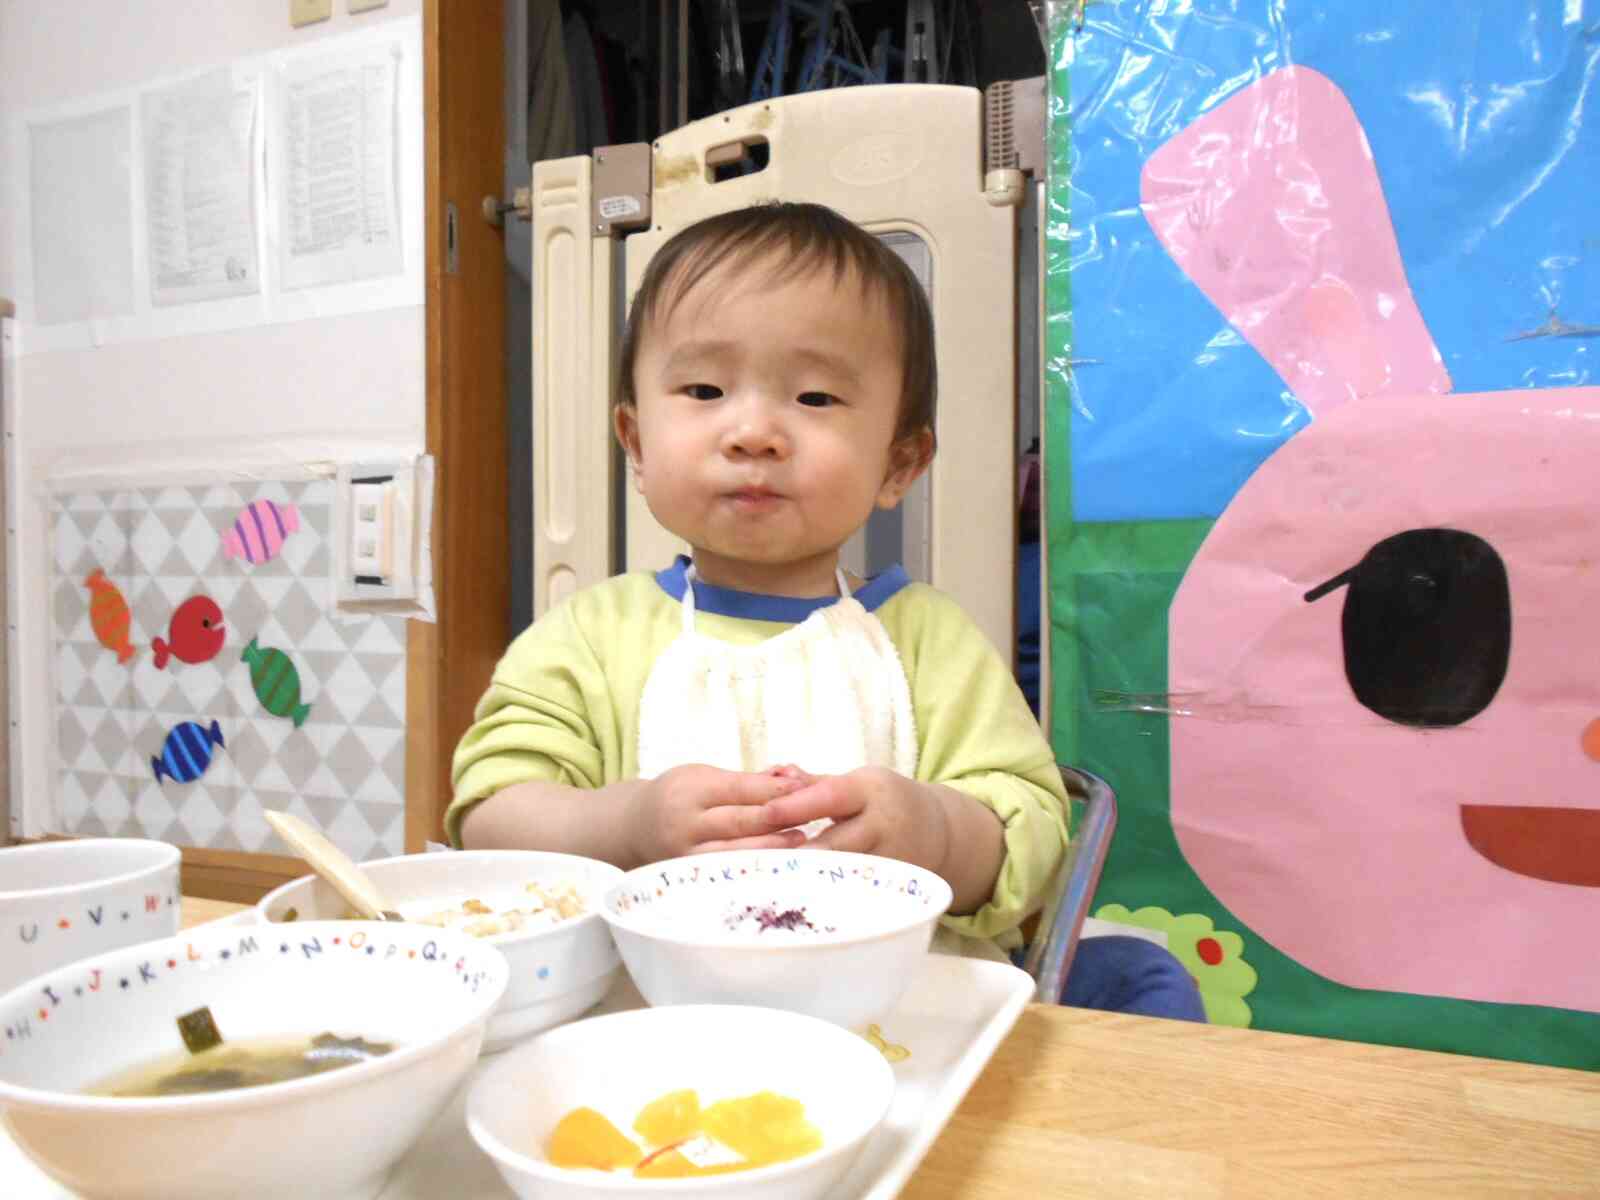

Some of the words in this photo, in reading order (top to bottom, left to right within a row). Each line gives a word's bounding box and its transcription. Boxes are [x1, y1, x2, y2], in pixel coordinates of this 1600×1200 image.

[722, 866, 734, 881] K
[829, 866, 844, 884] N
[19, 923, 39, 944] U
[87, 905, 103, 926] V
[88, 968, 102, 993] J
[138, 961, 157, 984] K
[186, 943, 202, 961] L
[239, 933, 260, 956] M
[301, 936, 323, 959] N
[349, 931, 367, 950] O
[422, 940, 438, 961] Q
